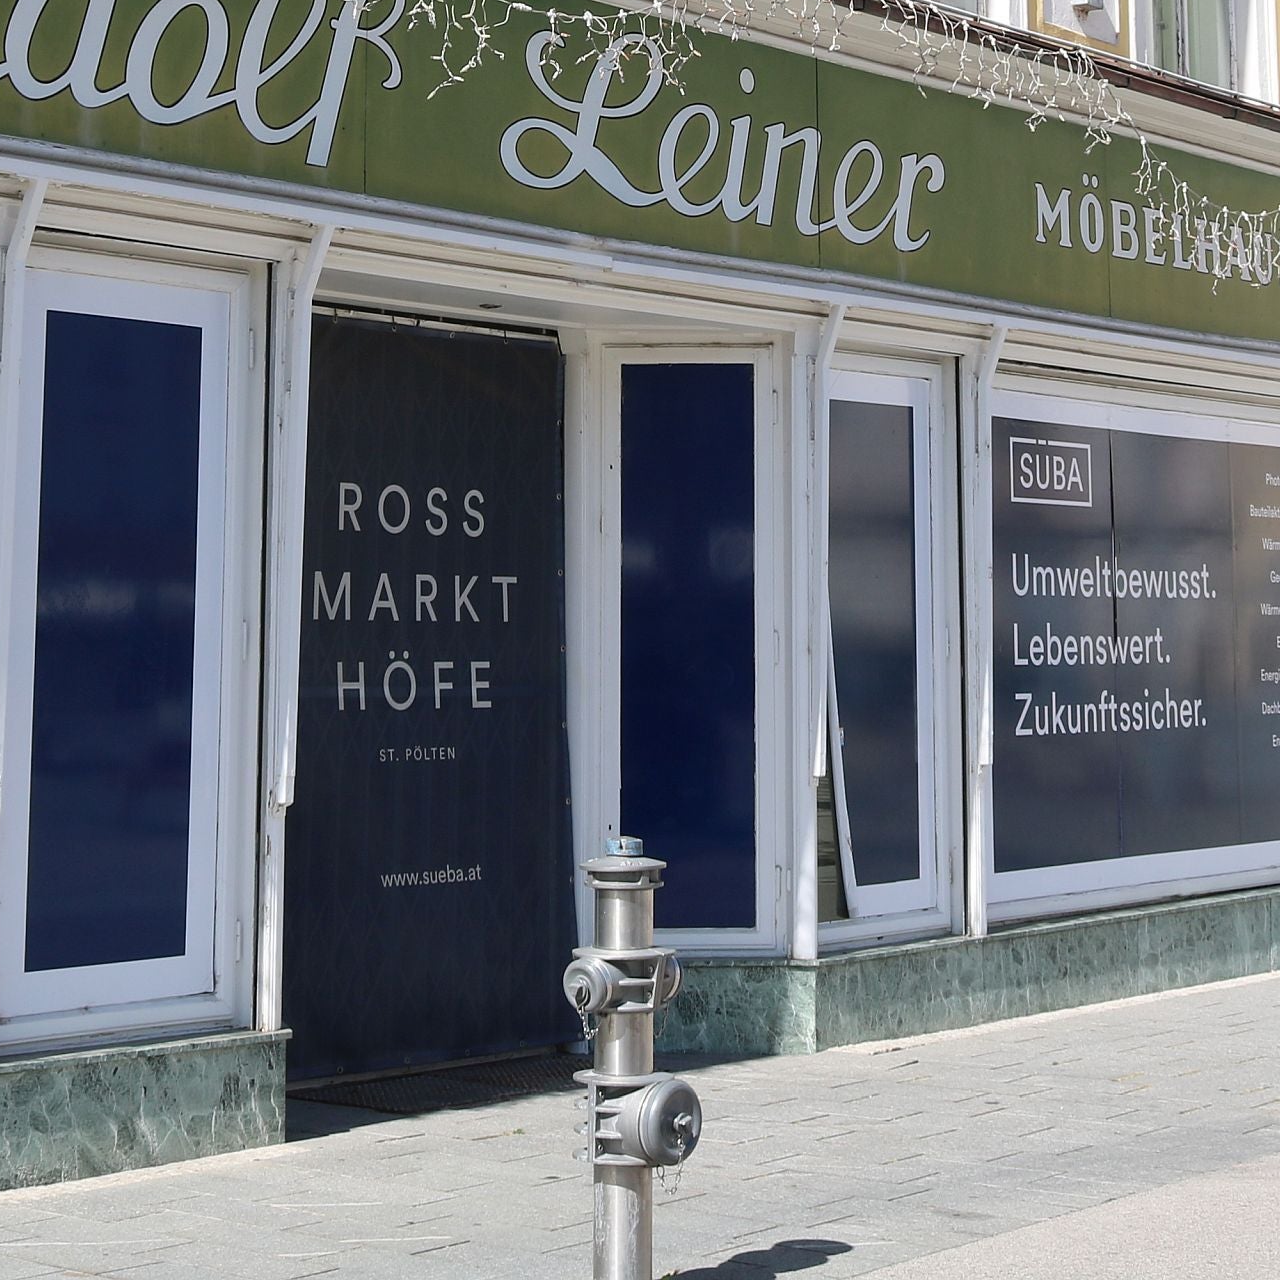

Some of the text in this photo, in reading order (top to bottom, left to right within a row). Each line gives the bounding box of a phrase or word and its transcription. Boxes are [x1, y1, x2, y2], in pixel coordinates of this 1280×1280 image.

[499, 29, 946, 253] Leiner
[338, 482, 485, 538] ROSS
[313, 570, 518, 623] MARKT
[1012, 553, 1217, 599] Umweltbewusst.
[1013, 622, 1171, 666] Lebenswert.
[337, 651, 492, 711] HÖFE
[1015, 688, 1207, 736] Zukunftssicher.
[379, 746, 456, 762] ST. PÖLTEN
[381, 864, 482, 888] www.sueba.at
